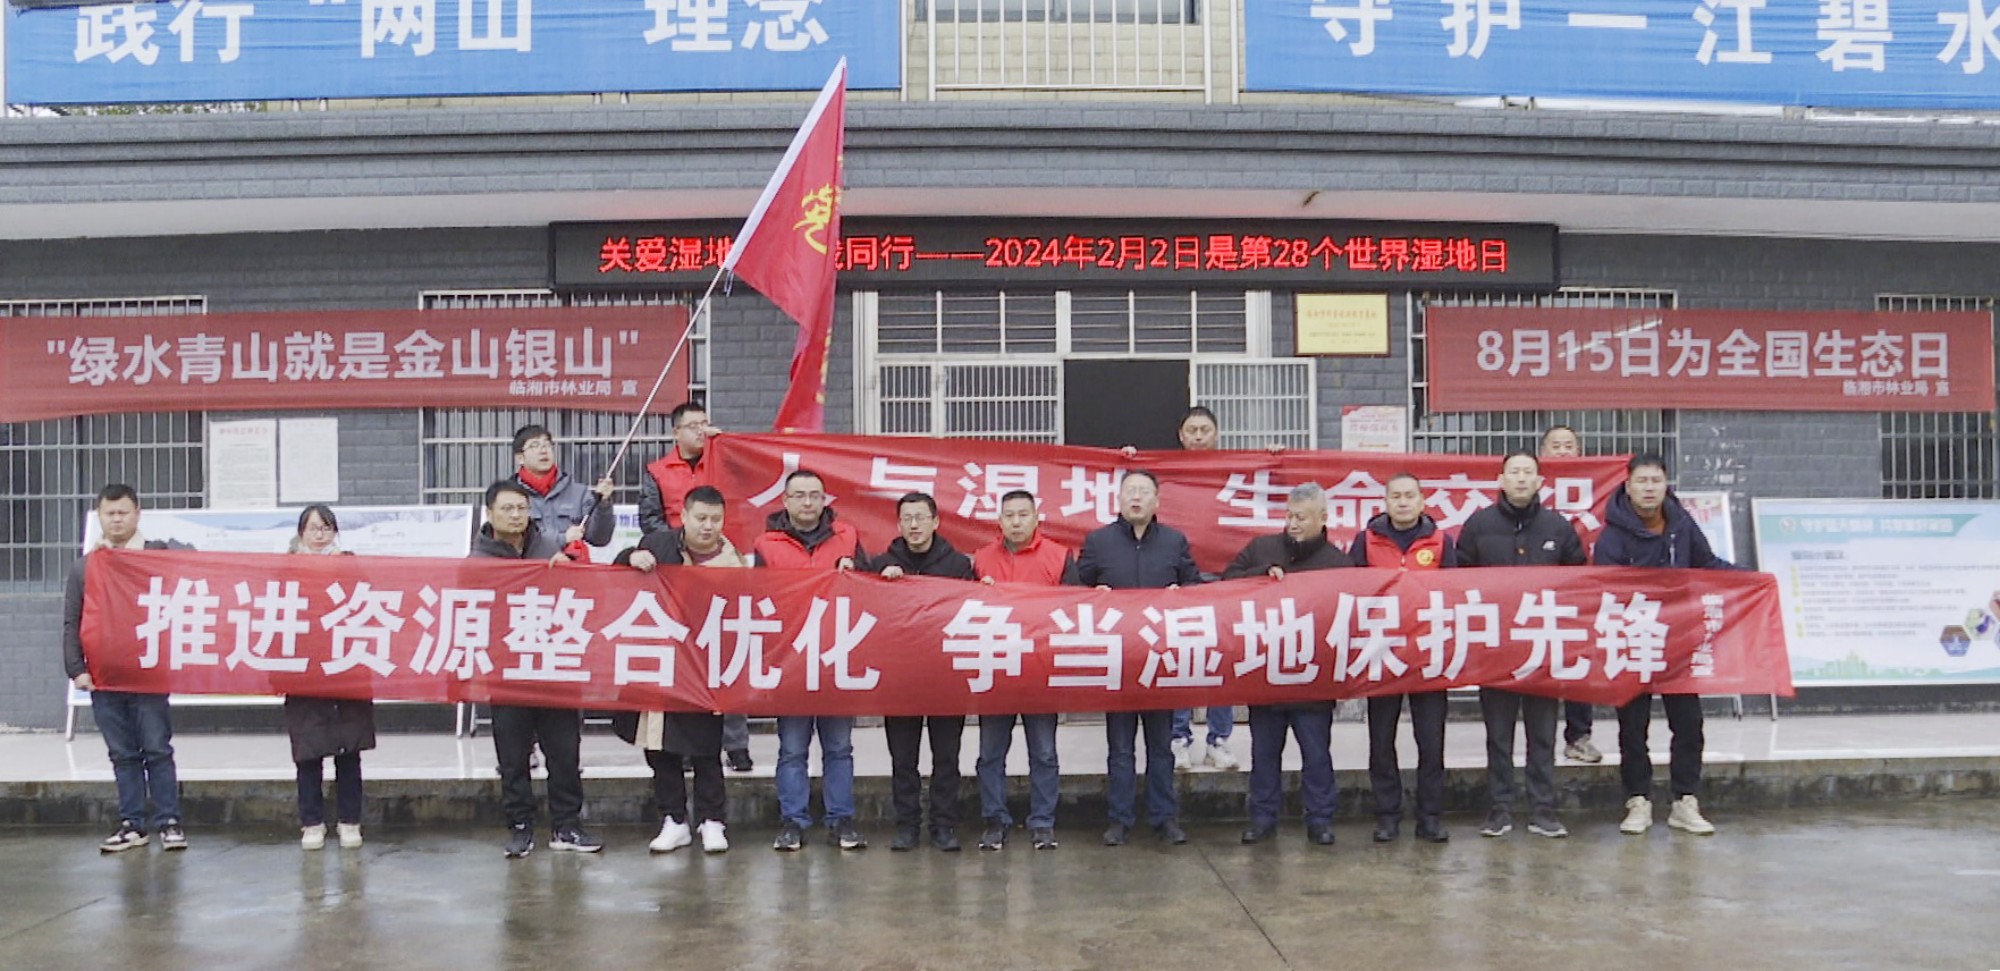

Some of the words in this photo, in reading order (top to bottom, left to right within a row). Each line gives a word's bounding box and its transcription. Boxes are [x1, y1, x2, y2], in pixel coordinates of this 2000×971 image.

[47, 326, 639, 386] "绿水青山就是金山银山"
[1476, 327, 1949, 379] 8月15日为全国生态日
[136, 576, 881, 692] 推进资源整合优化
[942, 589, 1670, 692] 争当湿地保护先锋
